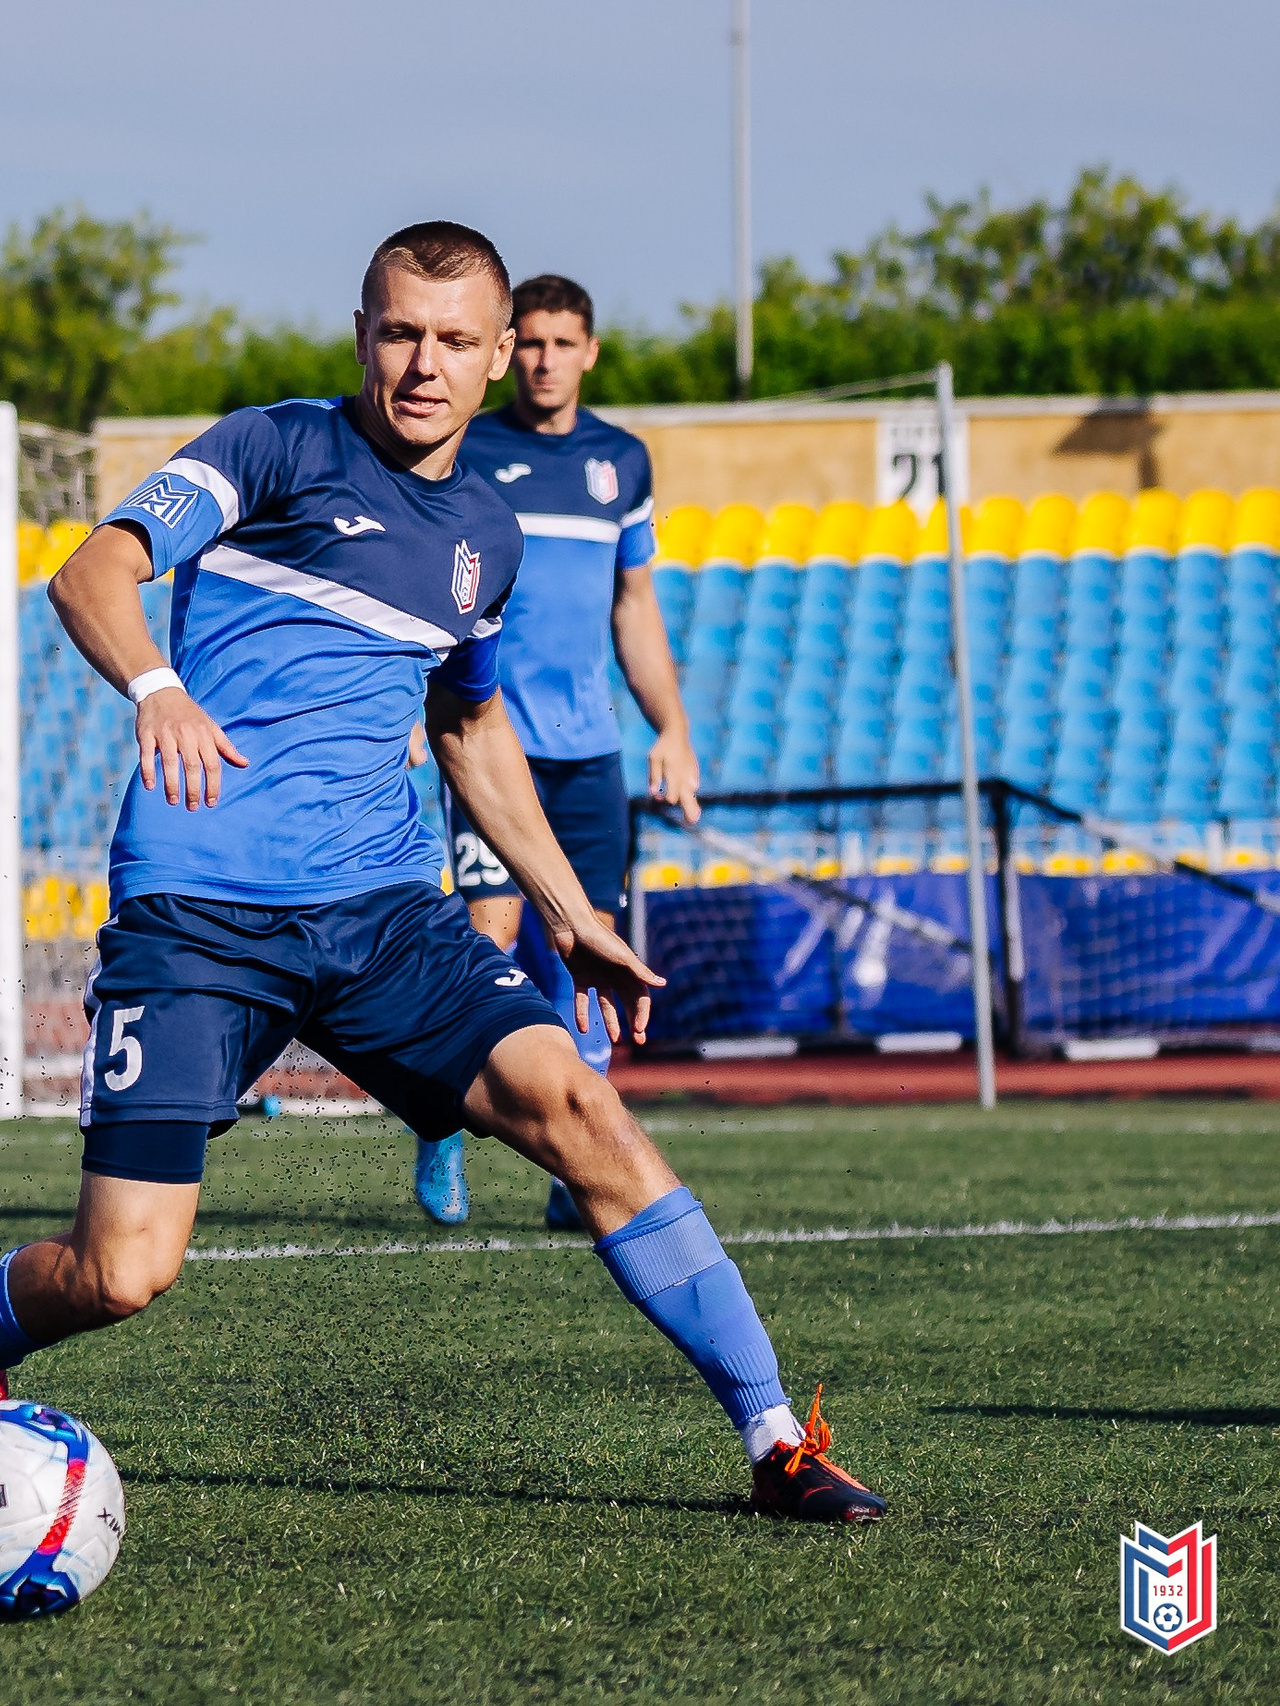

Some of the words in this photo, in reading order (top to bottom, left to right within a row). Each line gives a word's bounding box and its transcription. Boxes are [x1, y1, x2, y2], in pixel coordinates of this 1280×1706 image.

[892, 453, 946, 501] 21
[455, 832, 510, 886] 29
[104, 1006, 145, 1092] 5
